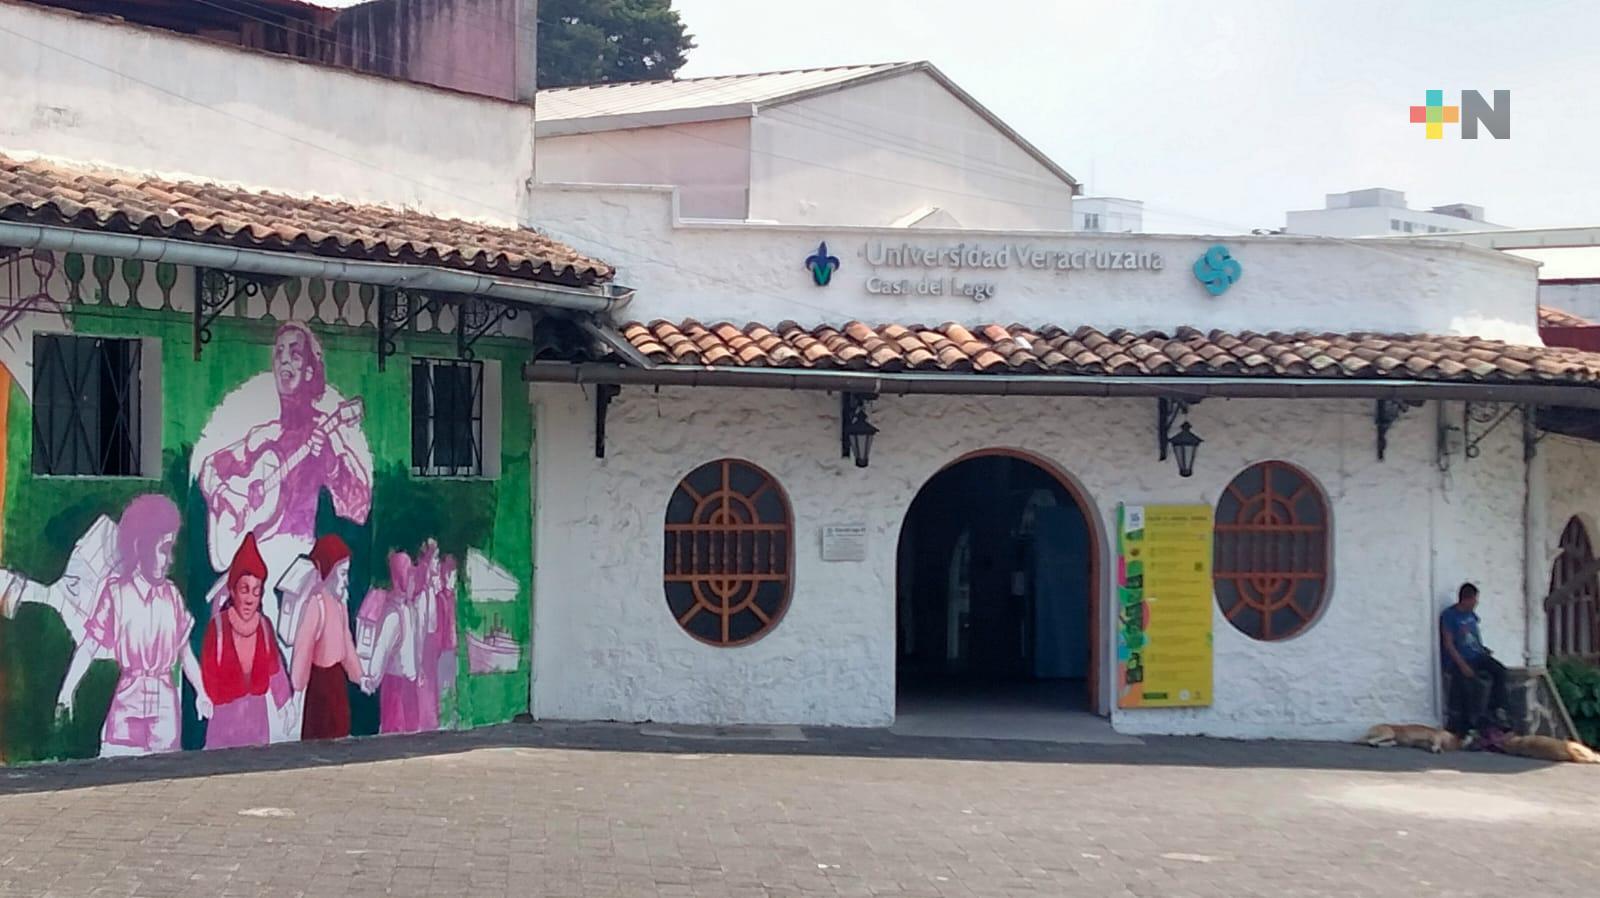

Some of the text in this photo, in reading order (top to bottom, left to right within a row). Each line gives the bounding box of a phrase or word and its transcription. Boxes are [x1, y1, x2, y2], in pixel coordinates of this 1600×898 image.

[865, 241, 1164, 270] Universidad Veracruzana
[865, 274, 996, 302] Casa del Lago
